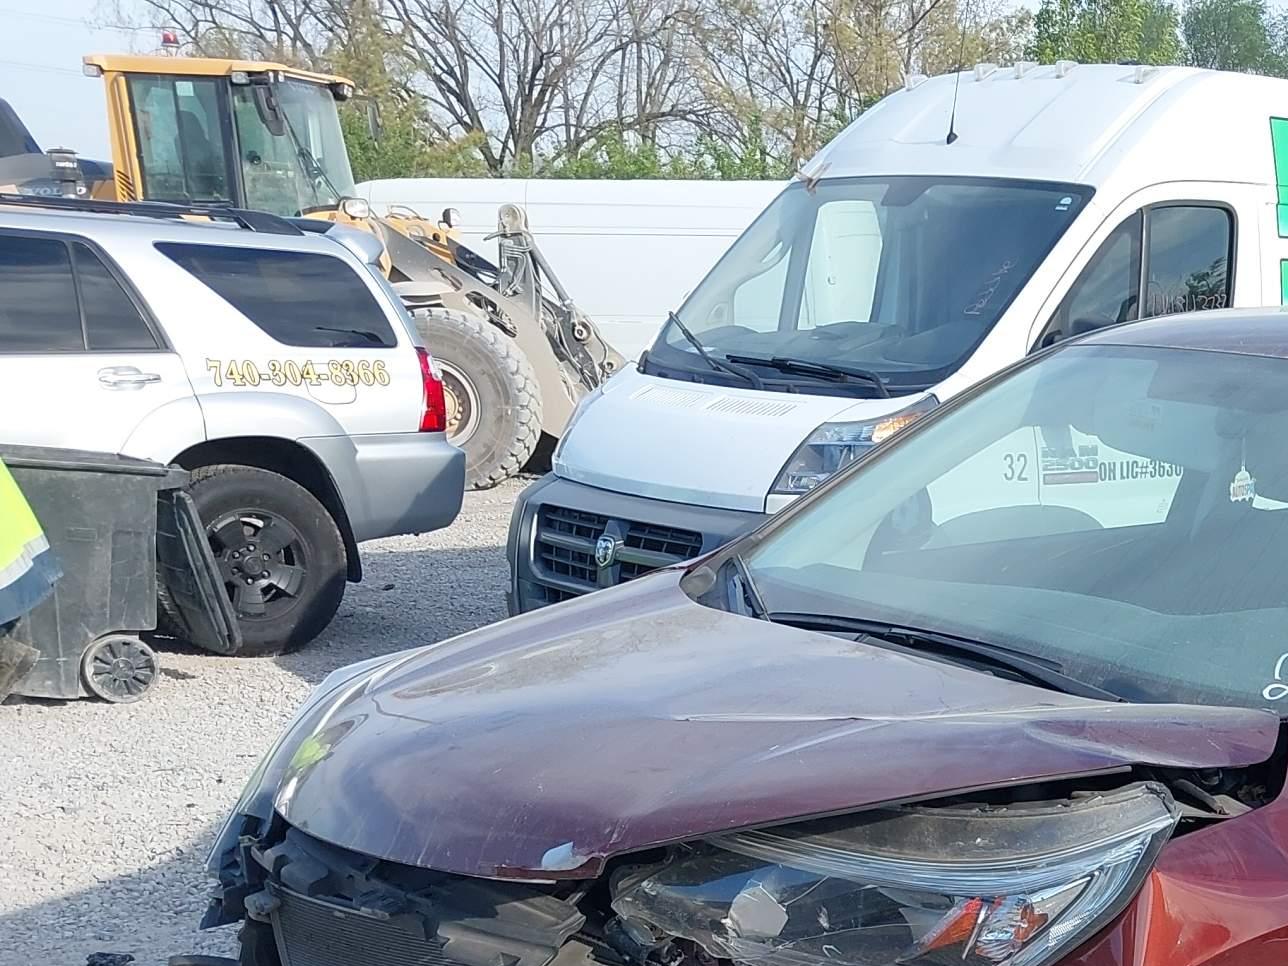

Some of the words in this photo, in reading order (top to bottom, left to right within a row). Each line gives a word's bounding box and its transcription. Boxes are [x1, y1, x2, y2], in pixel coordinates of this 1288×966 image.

[206, 358, 390, 387] 740-304-8366
[1003, 453, 1029, 482] 32
[1099, 462, 1117, 481] OH
